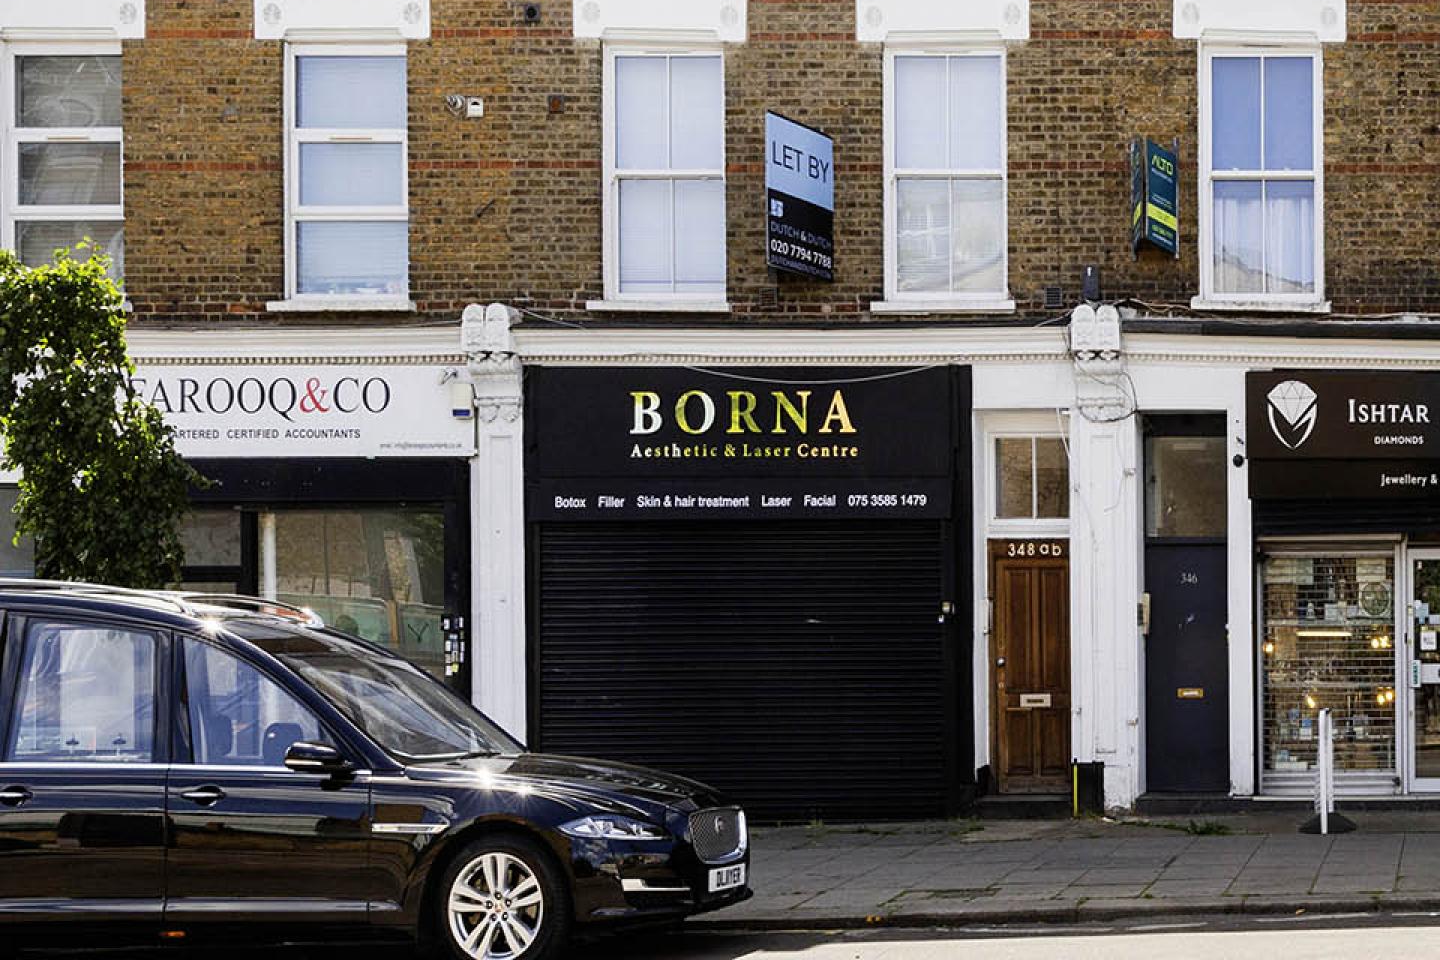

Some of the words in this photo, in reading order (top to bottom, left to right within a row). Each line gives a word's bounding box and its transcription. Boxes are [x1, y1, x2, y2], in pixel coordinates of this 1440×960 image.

[771, 140, 804, 172] LET
[808, 155, 829, 182] BY
[1152, 155, 1173, 176] ALTO
[771, 239, 789, 255] 020
[790, 244, 812, 261] 7794
[629, 389, 857, 435] BORNA
[1349, 399, 1430, 423] ISHTAR
[227, 428, 279, 439] CERTIFIED
[285, 428, 360, 439] ACCOUNTANTS
[1374, 436, 1424, 445] DIAMONDS
[630, 444, 717, 458] Aesthetic
[724, 444, 737, 457] &
[743, 444, 791, 457] Laser
[797, 444, 859, 458] Centre
[1380, 474, 1428, 486] Jewellery
[1431, 474, 1437, 484] &
[555, 496, 586, 508] Botox
[598, 496, 625, 507] Filler
[637, 495, 660, 507] Skin
[663, 496, 672, 507] &
[675, 496, 696, 507] hair
[698, 496, 750, 507] treatment
[762, 495, 792, 507] Laser
[804, 495, 837, 507] Facial
[848, 495, 868, 507] 075
[870, 495, 898, 507] 3585
[901, 495, 928, 507] 1479
[1008, 543, 1035, 556] 348
